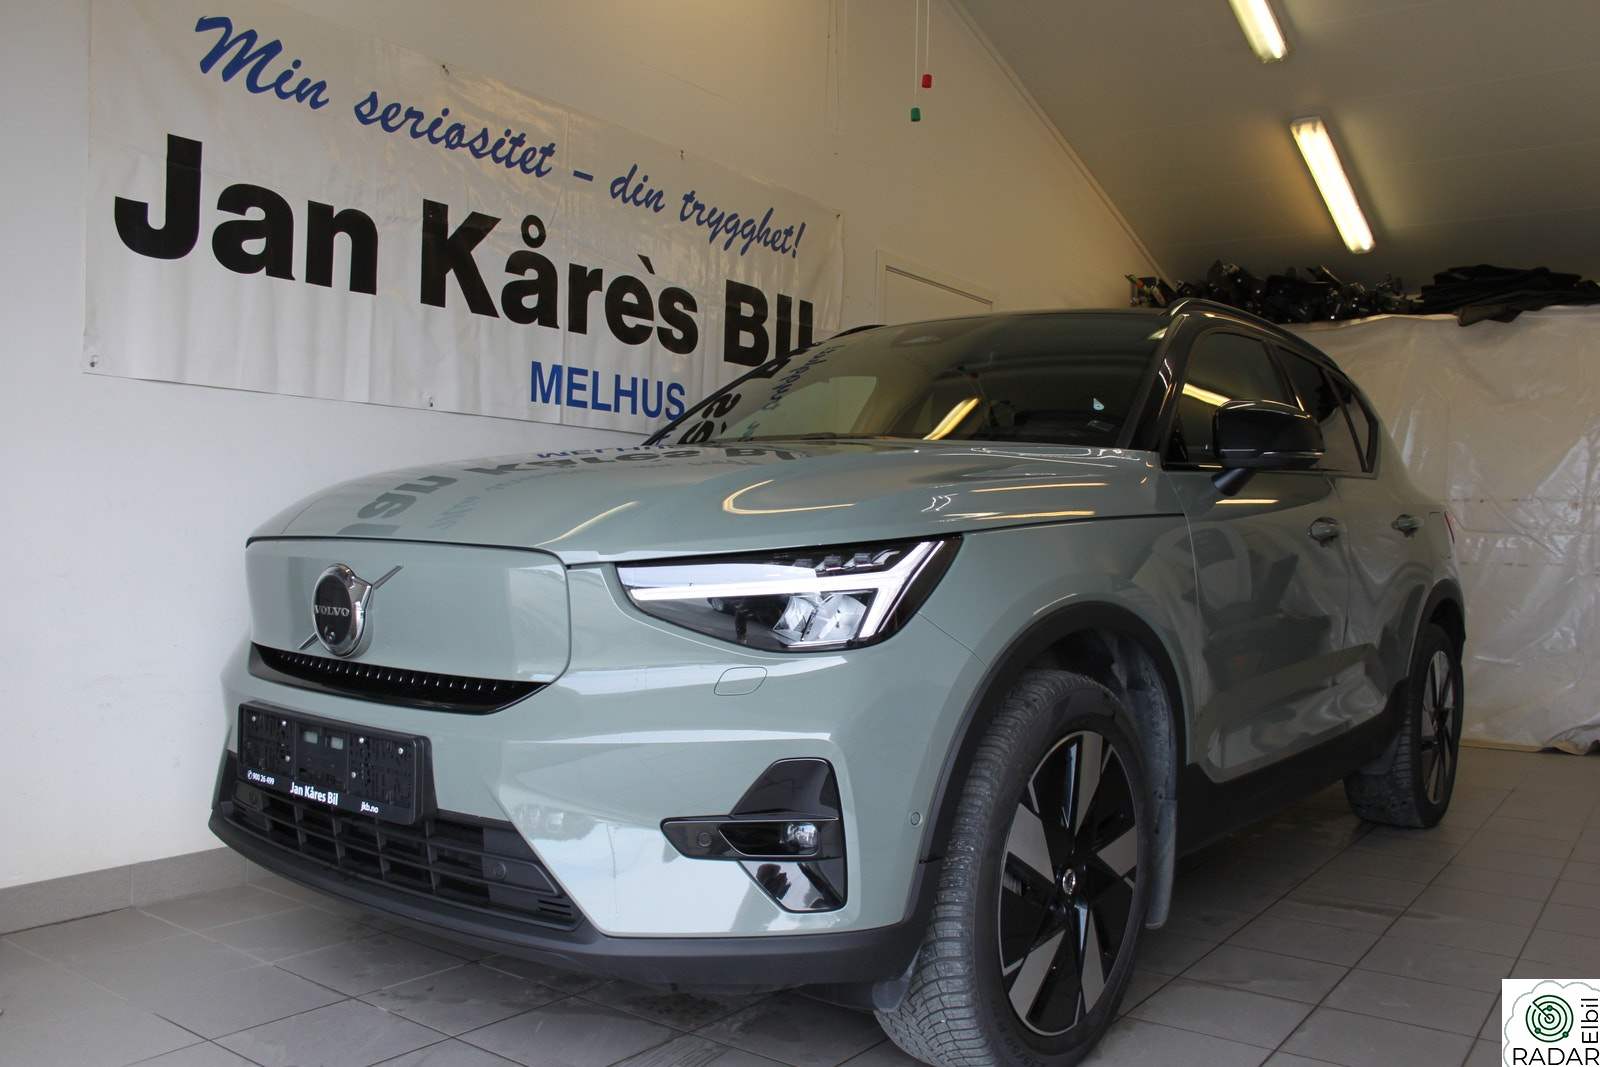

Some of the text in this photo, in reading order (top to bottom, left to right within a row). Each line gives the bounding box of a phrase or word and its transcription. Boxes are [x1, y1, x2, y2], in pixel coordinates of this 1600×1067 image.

[195, 15, 330, 110] Min
[354, 91, 556, 178] seriøsitet
[610, 163, 666, 213] din
[679, 190, 806, 259] trygghet!
[114, 133, 379, 296] Jan
[530, 360, 686, 421] MELHUS
[314, 604, 350, 617] VOLVO
[290, 782, 339, 806] Jan Kåres Bil
